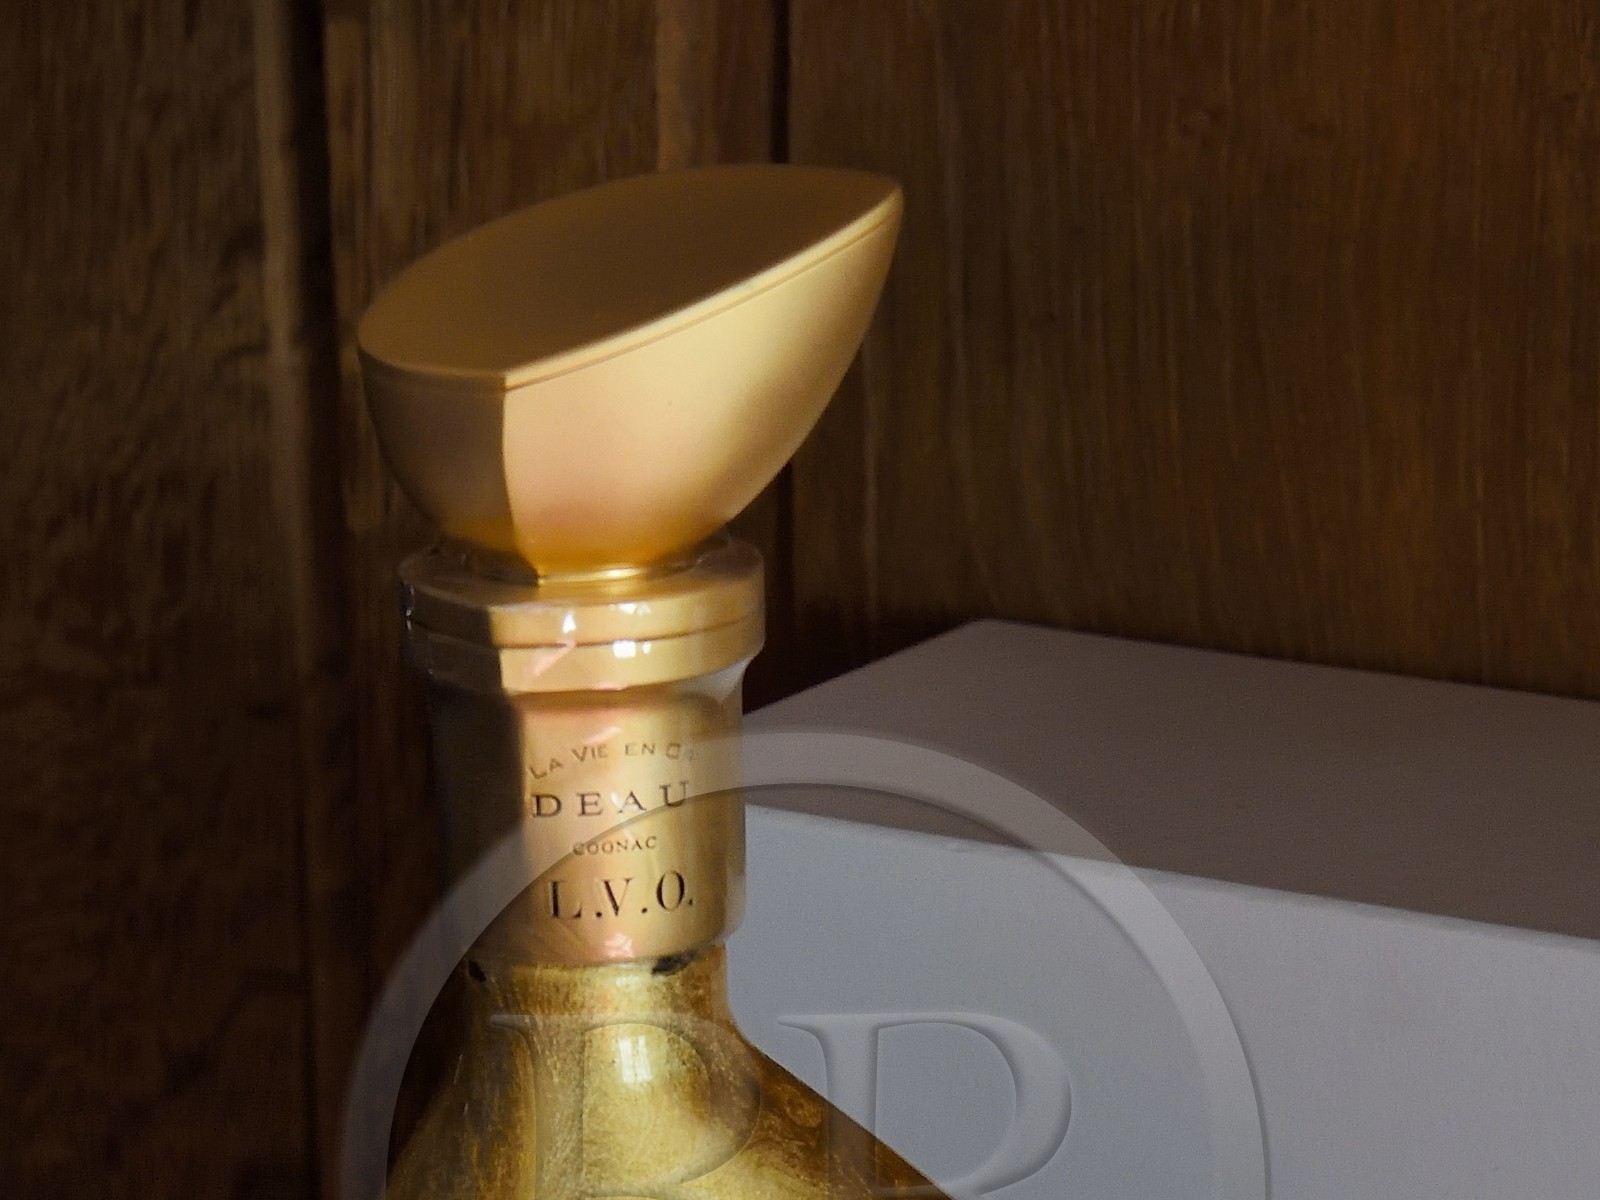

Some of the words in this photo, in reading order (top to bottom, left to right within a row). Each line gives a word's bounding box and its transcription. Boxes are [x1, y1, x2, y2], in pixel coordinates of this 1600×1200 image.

[528, 758, 563, 779] LA
[570, 743, 608, 762] VIE
[625, 743, 656, 757] EN
[530, 781, 689, 818] DEAU
[549, 869, 694, 919] L.V.O.
